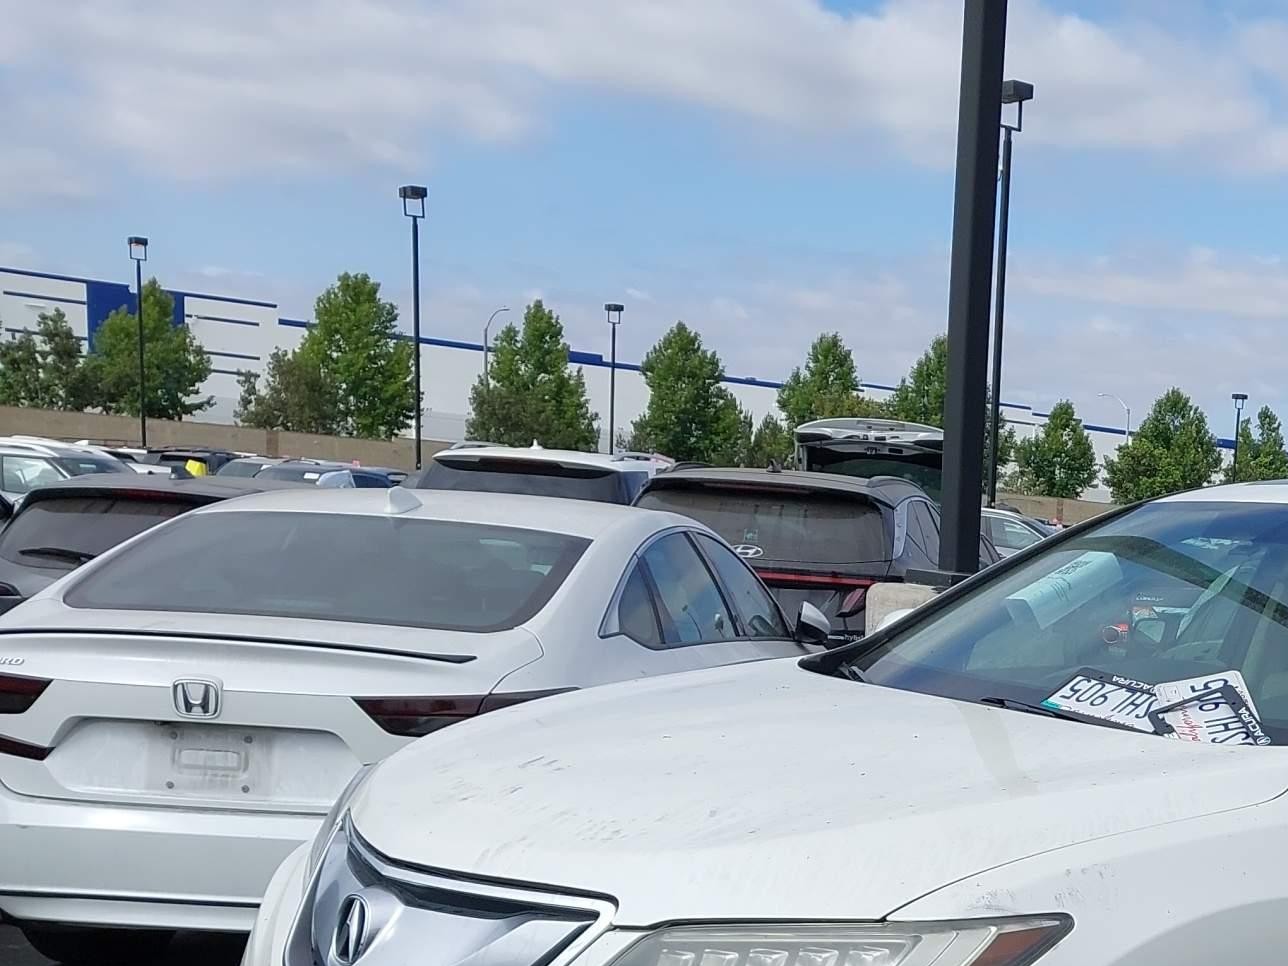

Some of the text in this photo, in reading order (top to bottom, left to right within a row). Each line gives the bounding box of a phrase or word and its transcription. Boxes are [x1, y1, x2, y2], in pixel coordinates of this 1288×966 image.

[1059, 678, 1124, 707] 905
[1112, 675, 1153, 690] ACURA
[1238, 706, 1265, 737] ACURA
